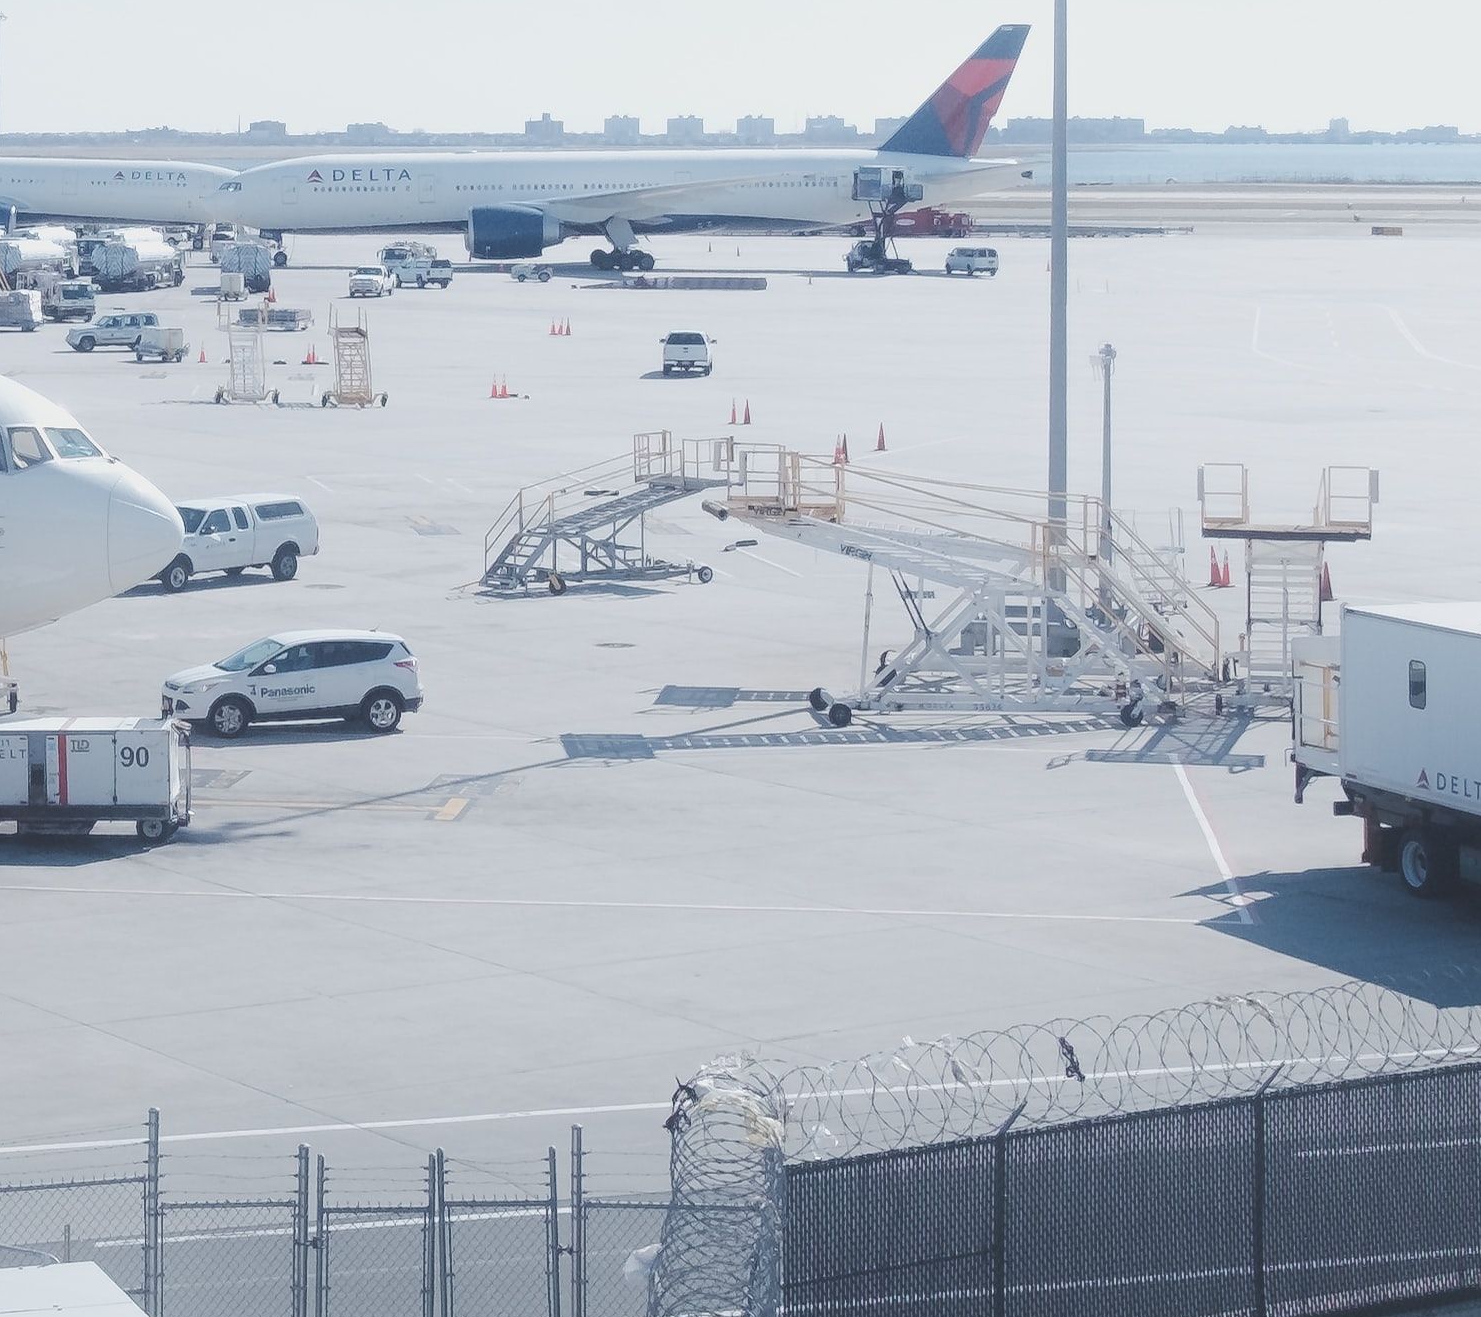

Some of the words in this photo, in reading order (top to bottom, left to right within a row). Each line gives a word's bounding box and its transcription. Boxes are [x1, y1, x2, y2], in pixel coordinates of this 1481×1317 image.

[131, 171, 186, 181] DELTA
[332, 168, 412, 182] DELTA
[260, 684, 316, 698] Panasonic
[70, 740, 90, 752] TLD
[120, 746, 150, 768] 90
